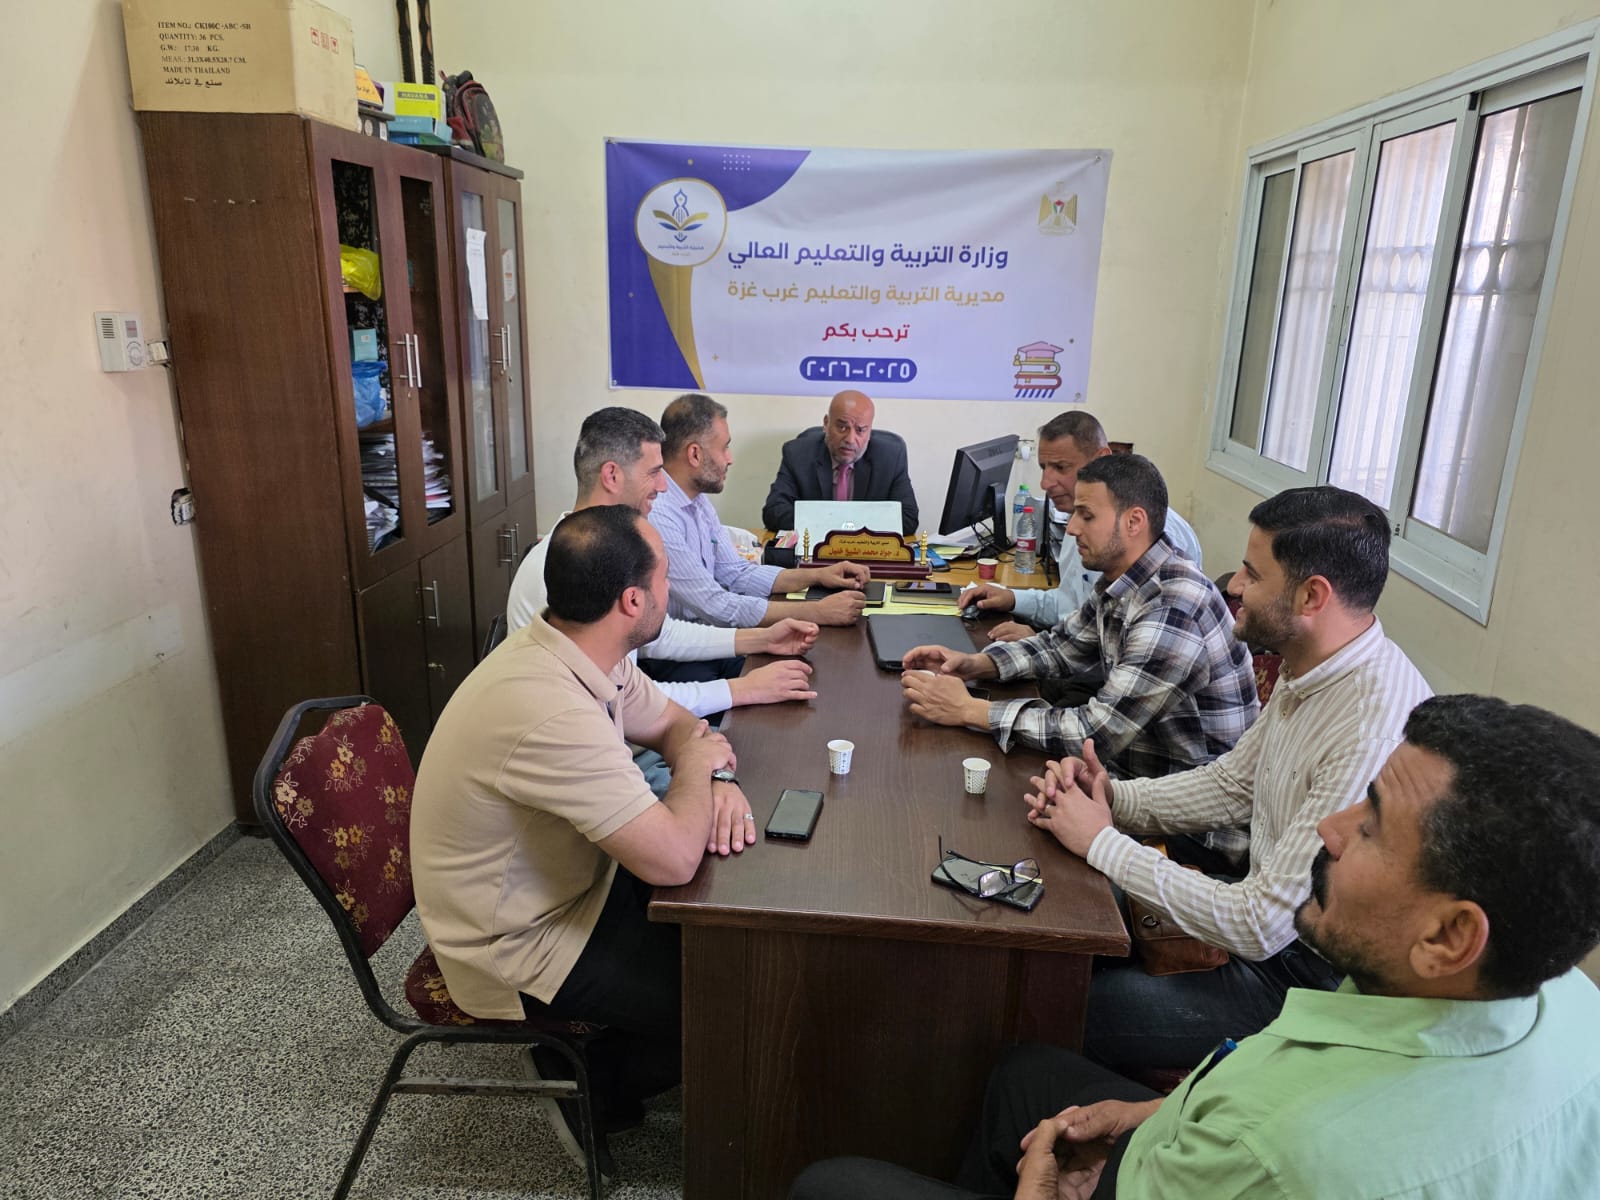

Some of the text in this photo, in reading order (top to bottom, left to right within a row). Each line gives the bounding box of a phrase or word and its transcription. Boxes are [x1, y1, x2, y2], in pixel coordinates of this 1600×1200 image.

[728, 242, 1008, 270] وزارة التربية والتعليم العالي
[728, 280, 1005, 306] مديرية التربية والتعليم غرب غزة
[822, 322, 910, 342] ترحب بكم
